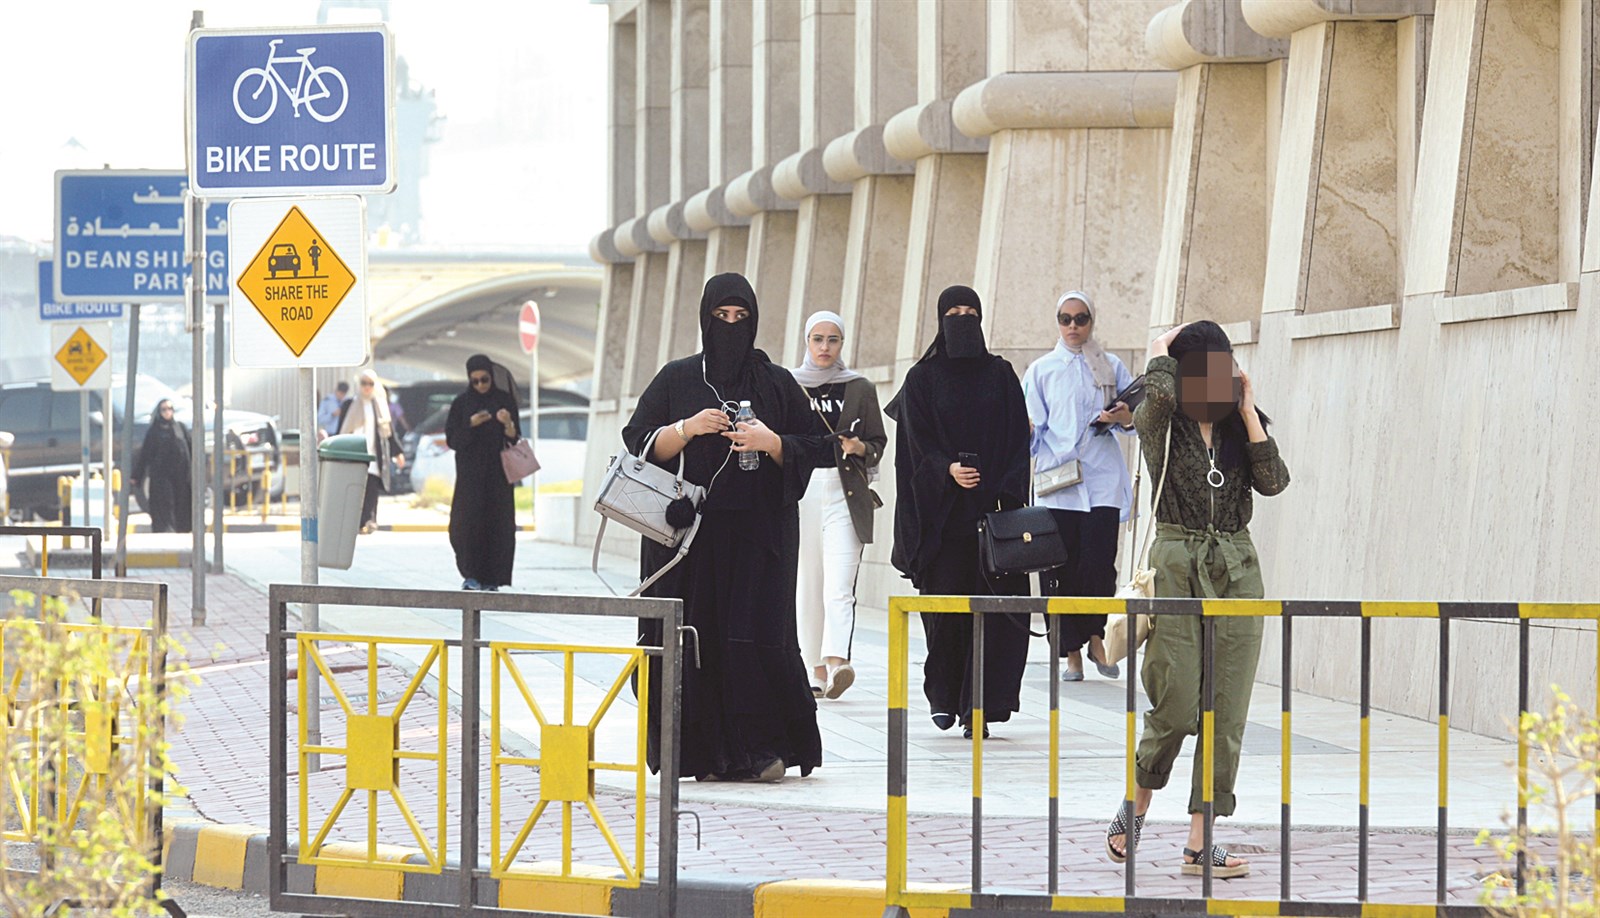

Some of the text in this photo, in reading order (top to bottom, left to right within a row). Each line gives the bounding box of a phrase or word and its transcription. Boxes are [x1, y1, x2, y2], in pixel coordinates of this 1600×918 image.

[206, 143, 376, 173] BIKE ROUTE
[265, 284, 329, 301] SHARE THE
[43, 302, 73, 315] BIKE
[281, 306, 314, 321] ROAD
